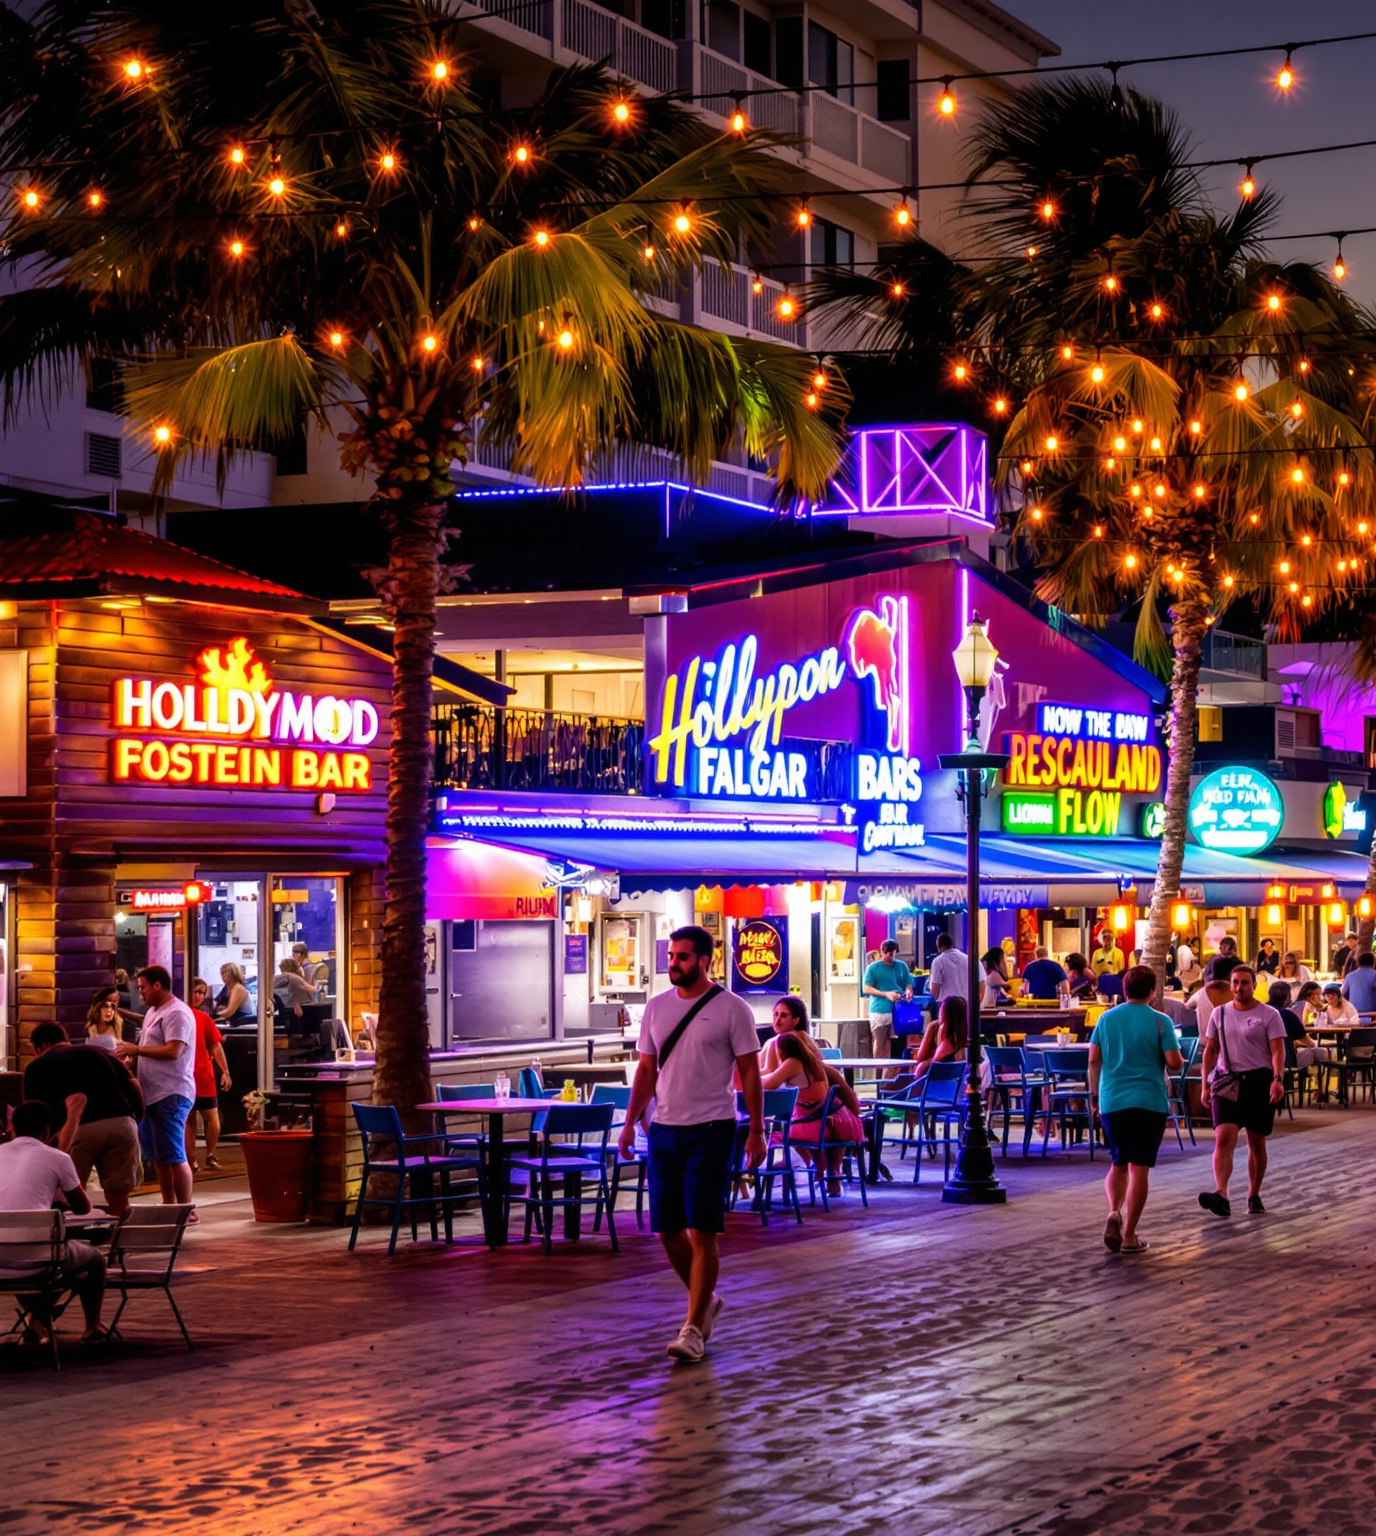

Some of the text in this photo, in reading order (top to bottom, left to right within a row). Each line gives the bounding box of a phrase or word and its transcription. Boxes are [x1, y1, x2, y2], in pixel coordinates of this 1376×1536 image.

[1085, 710, 1112, 738] THE
[115, 738, 370, 790] FOSTEIN BAR
[699, 747, 808, 798] FALGAR
[858, 754, 923, 802] BARS
[1009, 733, 1162, 793] RESCAULAND
[1058, 788, 1122, 836] FLOW
